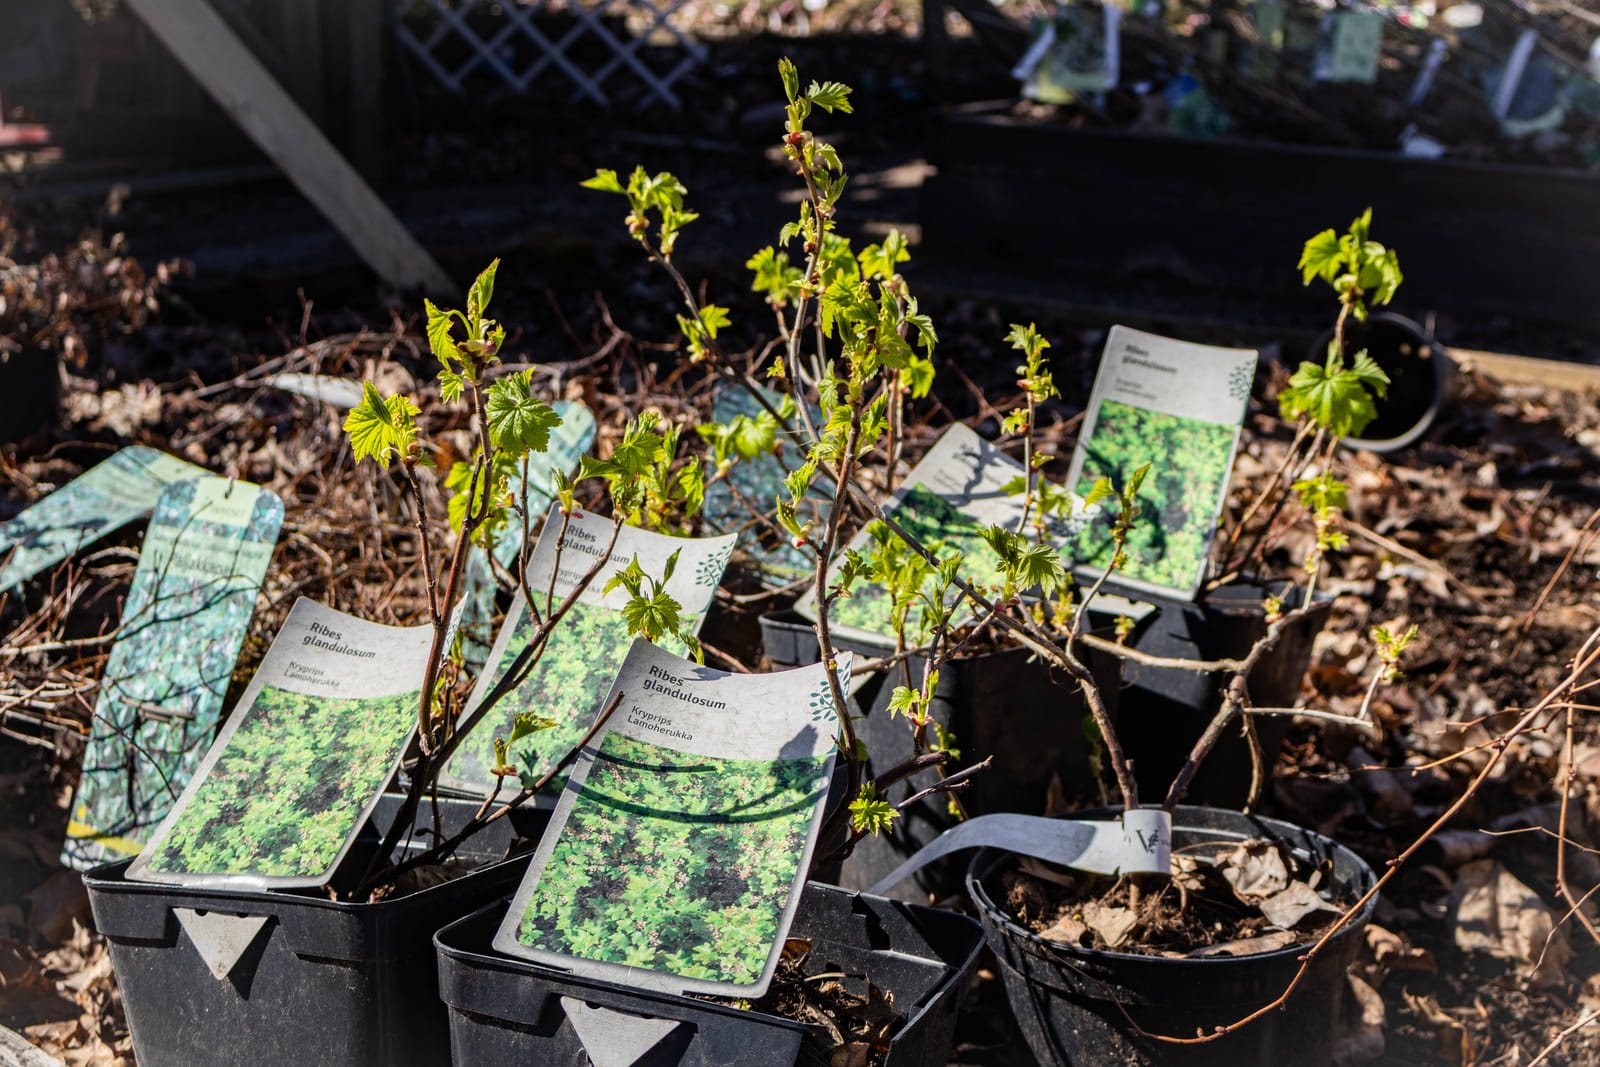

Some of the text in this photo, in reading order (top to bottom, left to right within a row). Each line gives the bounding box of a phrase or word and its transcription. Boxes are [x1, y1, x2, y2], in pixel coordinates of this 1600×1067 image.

[567, 524, 597, 542] Ribes
[310, 622, 342, 640] Ribes
[302, 635, 376, 658] glandulosum
[649, 665, 684, 687] Ribes
[643, 679, 727, 710] glandulosum
[631, 705, 673, 726] Kryprips
[627, 714, 694, 741] Lamoherukka
